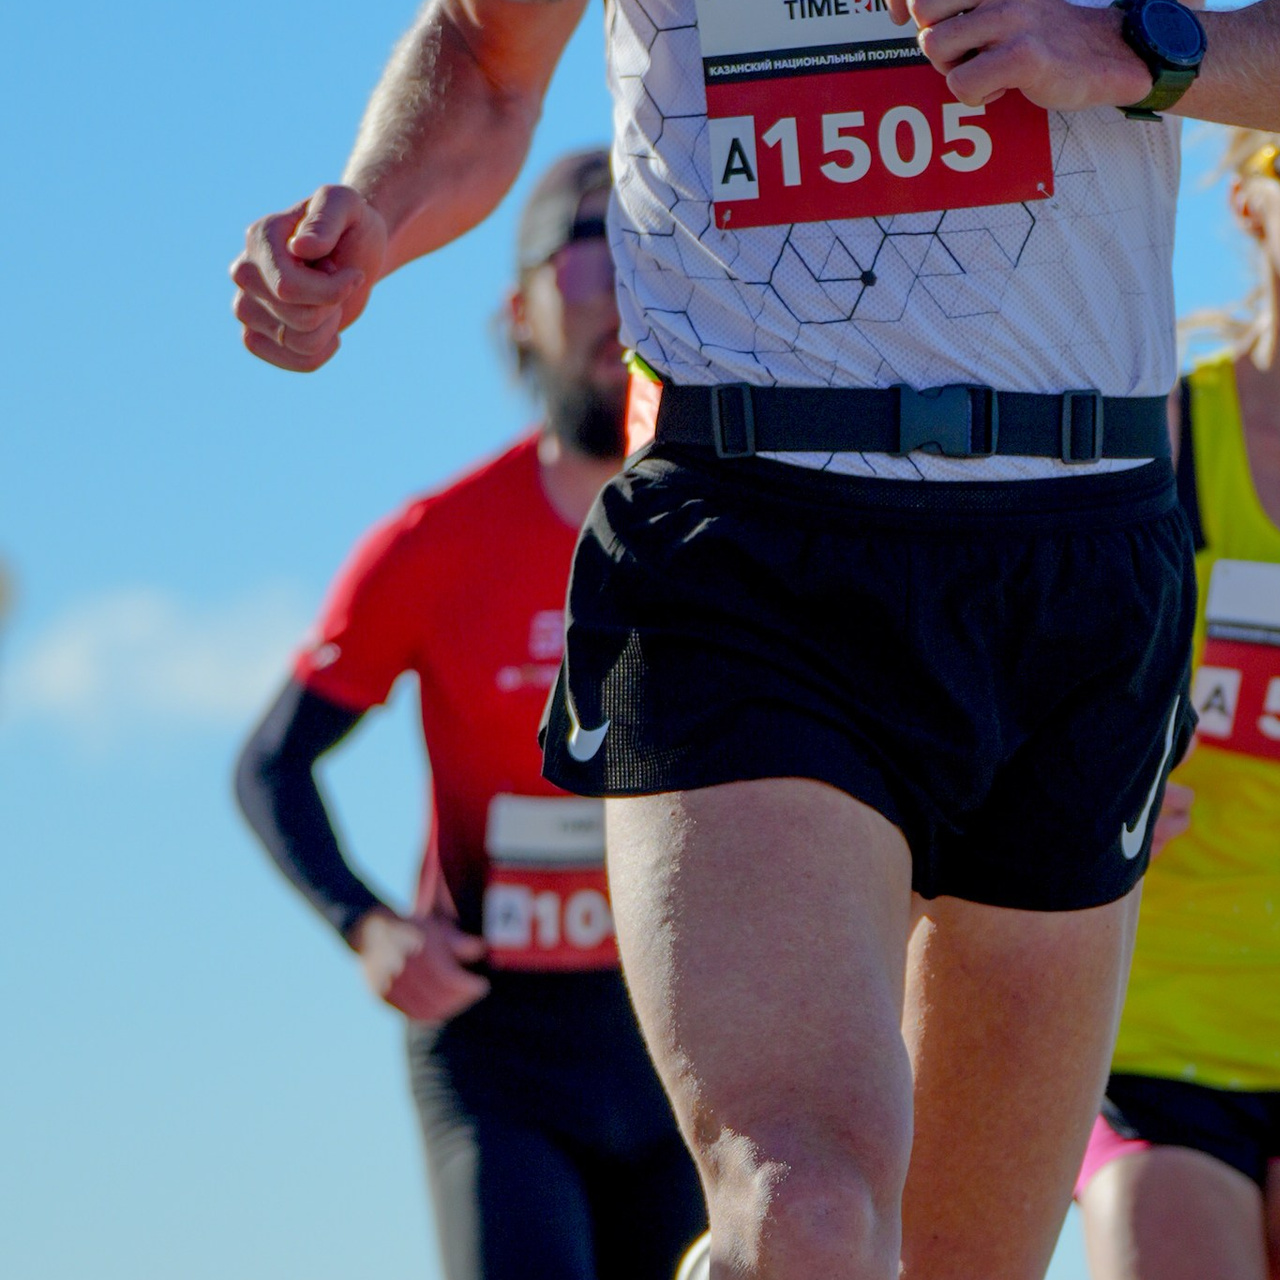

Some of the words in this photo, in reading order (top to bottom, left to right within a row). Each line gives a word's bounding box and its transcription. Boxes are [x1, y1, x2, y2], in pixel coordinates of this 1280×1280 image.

[709, 58, 773, 77] КАЗАНСКИЙ
[773, 49, 866, 70] НАЦИОНАЛЬНЫЙ
[868, 46, 925, 62] ПОЛУМАР
[720, 136, 756, 186] A
[761, 101, 994, 188] 1505
[533, 888, 616, 951] 10
